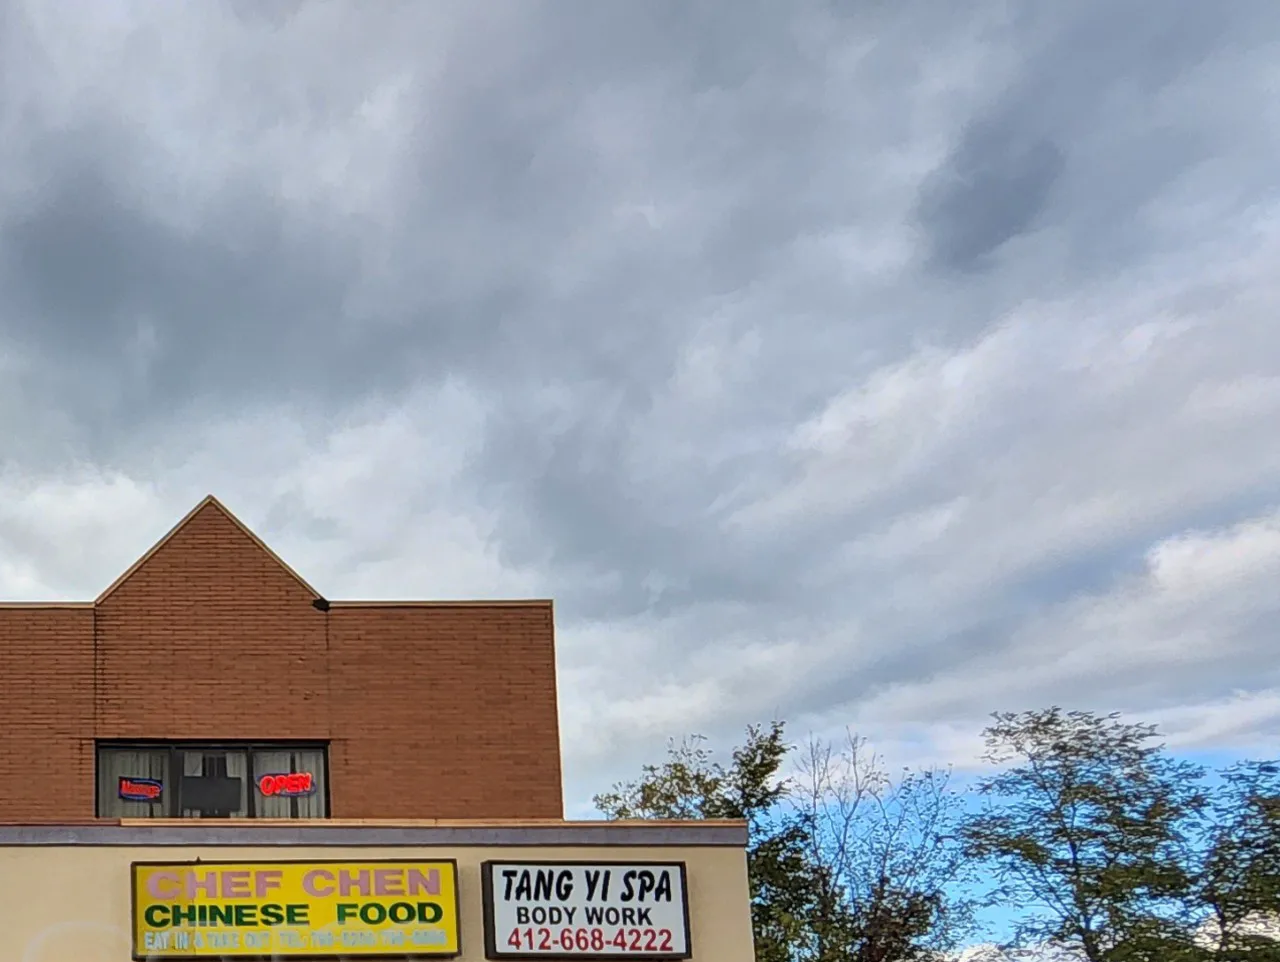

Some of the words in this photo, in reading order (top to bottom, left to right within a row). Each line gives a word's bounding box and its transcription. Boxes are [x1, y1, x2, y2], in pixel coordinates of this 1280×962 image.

[259, 772, 312, 796] OPEN
[147, 870, 284, 900] CHEF
[302, 868, 441, 897] CHEN
[502, 869, 574, 901] TANG
[585, 869, 611, 901] YI
[620, 869, 672, 902] SPA
[144, 903, 310, 927] CHINESE
[336, 902, 444, 925] FOOD
[516, 906, 577, 925] BODY
[585, 907, 653, 926] WORK
[145, 931, 169, 949] EAT
[174, 931, 190, 949] IN
[244, 931, 271, 948] OUT
[507, 927, 673, 951] 412-668-4222
